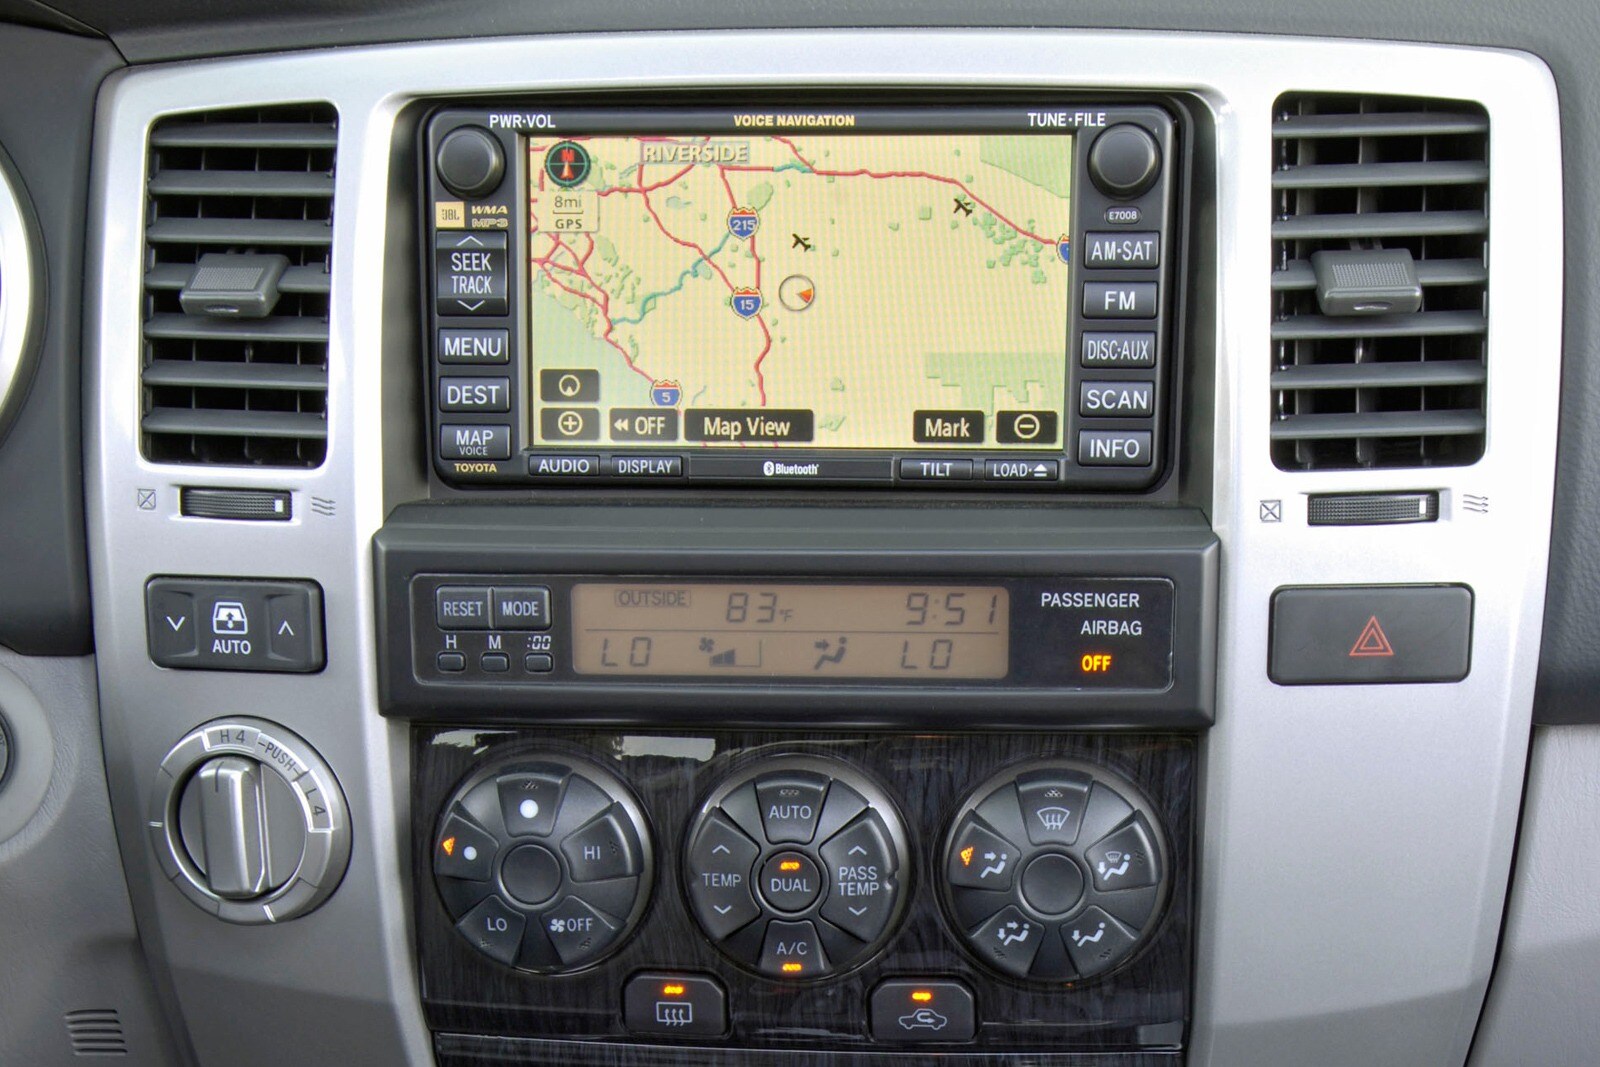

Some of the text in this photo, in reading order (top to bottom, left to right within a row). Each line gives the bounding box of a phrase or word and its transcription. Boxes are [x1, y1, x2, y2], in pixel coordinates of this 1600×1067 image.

[733, 114, 855, 127] VOICE NAVIGATION
[561, 149, 575, 162] N
[643, 144, 749, 163] RIVERSIDE
[441, 208, 460, 221] JBL
[471, 205, 508, 215] WMA
[1108, 210, 1137, 221] E7008
[555, 219, 583, 230] GPS
[732, 219, 756, 231] 215
[451, 253, 491, 272] SEEK
[451, 275, 492, 294] TRACK
[739, 299, 755, 311] 15
[1104, 291, 1136, 310] FM
[444, 338, 502, 357] MENU
[447, 385, 500, 404] DEST
[661, 392, 672, 403] 5
[1086, 389, 1148, 410] SCAN
[634, 416, 666, 435] OFF
[703, 417, 791, 440] Map View
[925, 418, 970, 438] Mark
[456, 430, 493, 446] MAP
[459, 446, 488, 456] VOICE
[1089, 439, 1140, 459] INFO
[454, 463, 497, 473] TOYOTA
[538, 459, 590, 474] AUDIO
[618, 459, 673, 475] DISPLAY
[775, 463, 818, 475] Bluetooth
[920, 462, 952, 477] TILT
[618, 590, 687, 606] OUTSIDE
[1041, 592, 1140, 608] PASSENGER
[443, 601, 483, 616] RESET
[502, 601, 539, 616] MODE
[906, 592, 997, 626] 9:51
[1080, 620, 1142, 636] AIRBAG
[212, 639, 251, 655] AUTO
[446, 635, 457, 649] H
[489, 635, 501, 649] M
[602, 637, 651, 667] LO
[901, 638, 953, 670] LO
[1081, 654, 1112, 672] OFF
[769, 805, 812, 820] AUTO
[584, 846, 601, 860] HI
[702, 872, 742, 888] TEMP
[838, 866, 878, 881] PASS
[770, 877, 811, 893] DUAL
[838, 881, 880, 897] TEMP
[486, 917, 507, 932] LO
[566, 917, 594, 932] OFF
[776, 941, 808, 956] A/C
